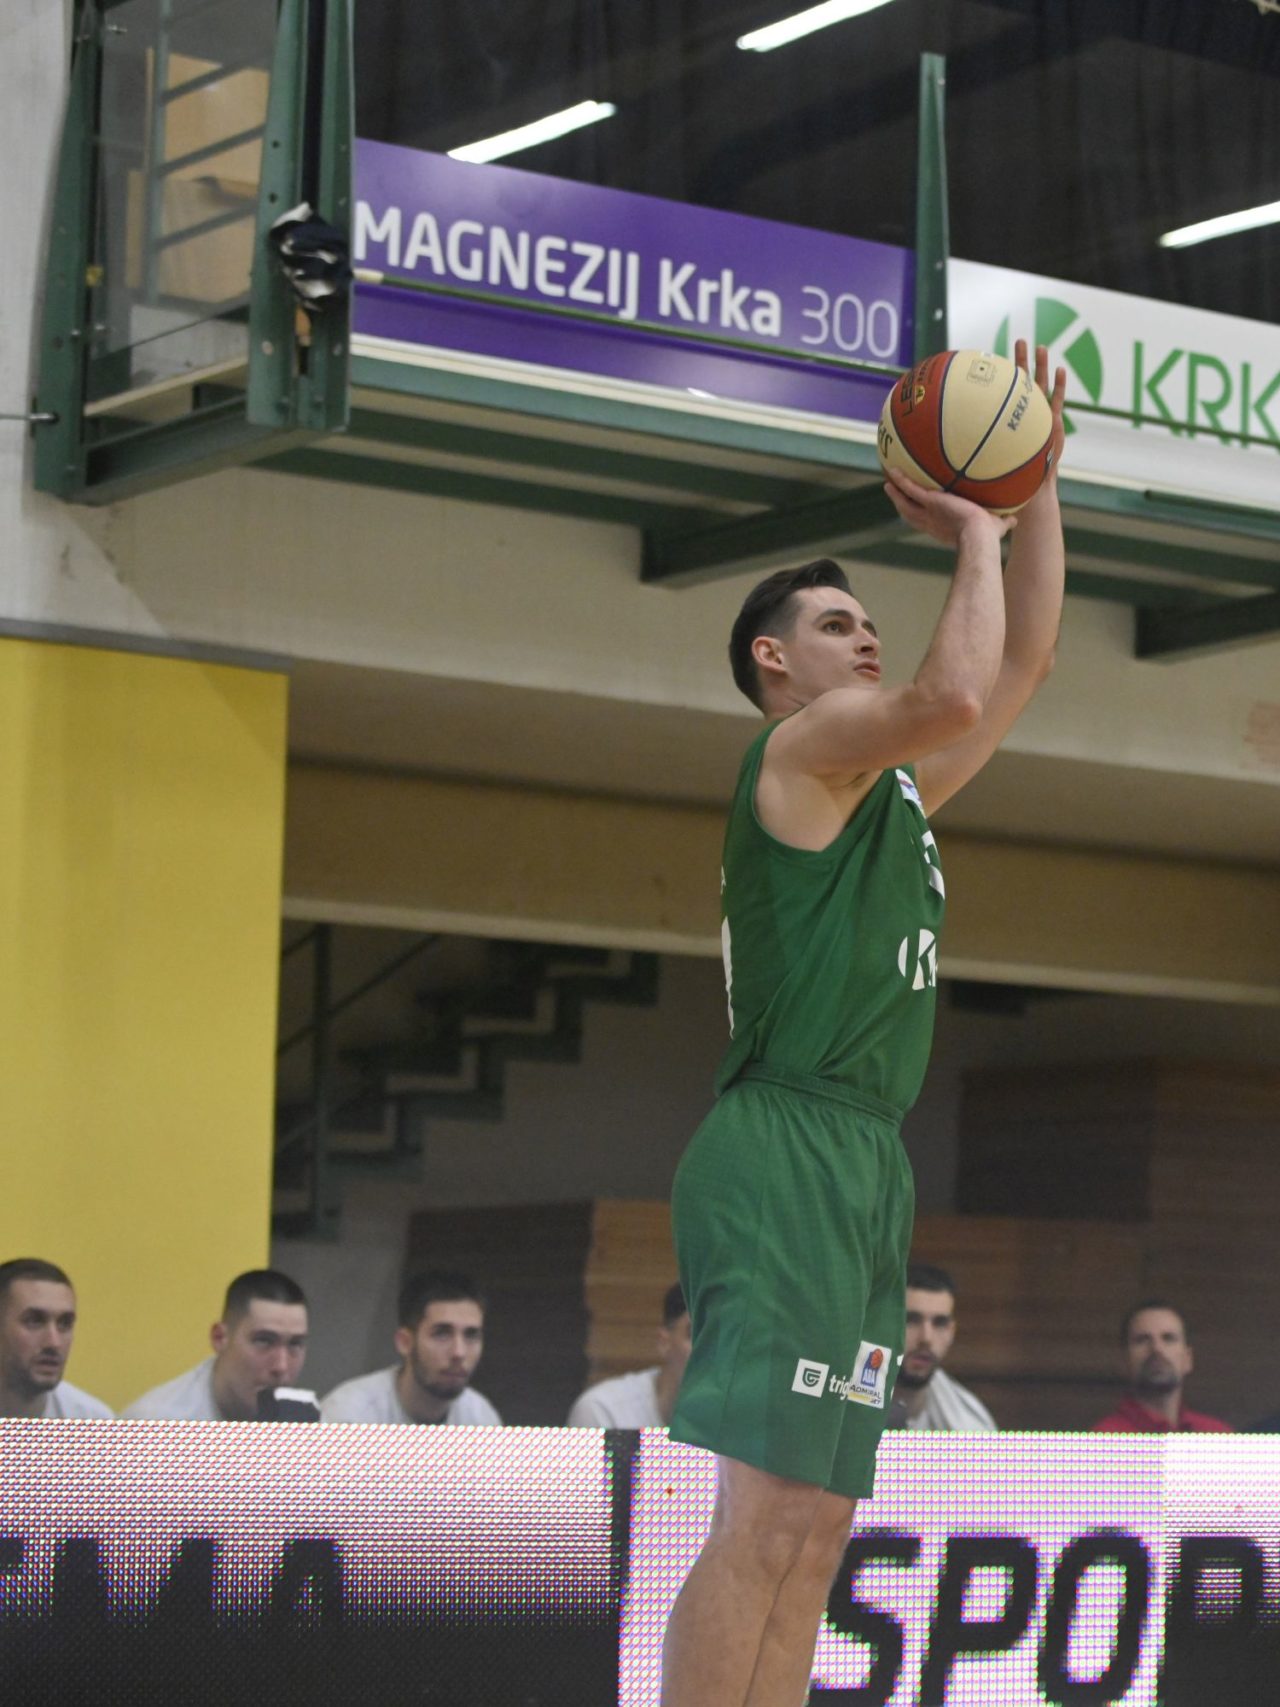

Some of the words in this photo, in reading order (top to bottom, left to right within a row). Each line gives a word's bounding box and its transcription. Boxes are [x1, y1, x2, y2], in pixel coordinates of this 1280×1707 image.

[354, 201, 640, 319] MAGNEZIJ
[657, 259, 783, 337] Krka
[800, 285, 899, 359] 300
